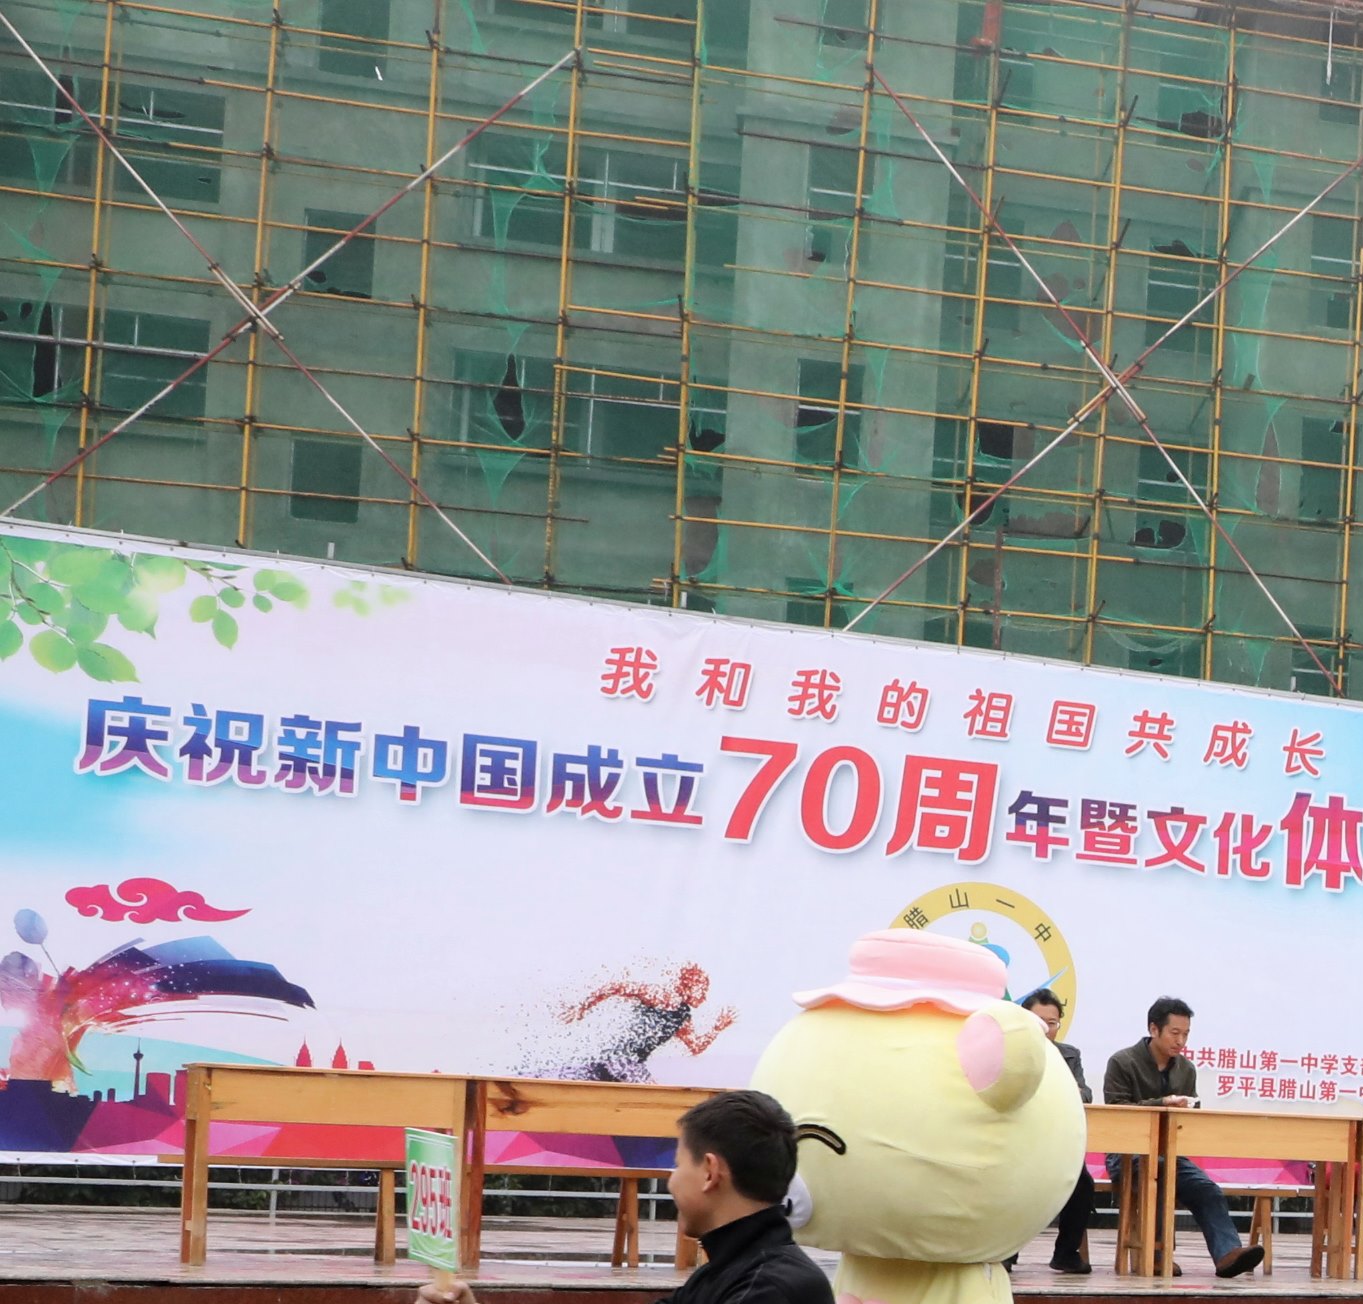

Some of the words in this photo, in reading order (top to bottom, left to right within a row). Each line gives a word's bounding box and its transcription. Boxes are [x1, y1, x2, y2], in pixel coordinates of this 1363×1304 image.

[600, 646, 1326, 778] 我和我的祖国共成长
[411, 1162, 453, 1239] 295班
